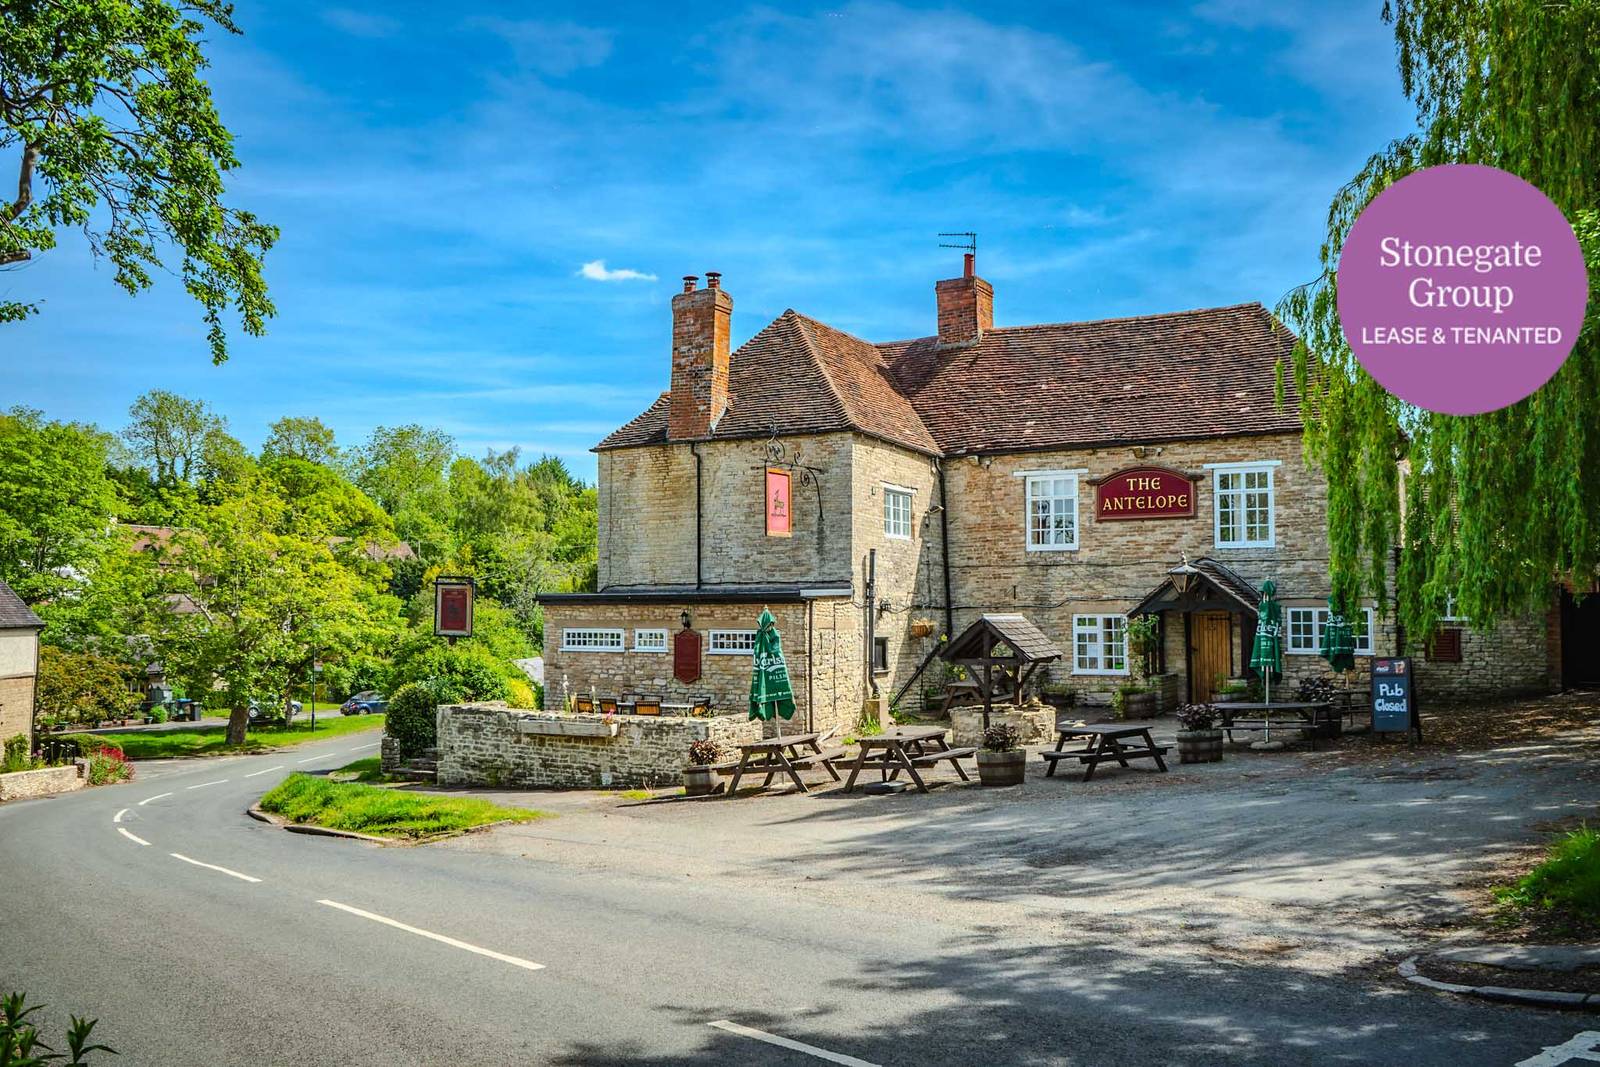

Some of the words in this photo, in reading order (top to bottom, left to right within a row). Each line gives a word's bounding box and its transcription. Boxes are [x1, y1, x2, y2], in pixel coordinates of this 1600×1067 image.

[1126, 477, 1161, 491] THE
[1102, 494, 1188, 511] ANTELOPE
[1379, 683, 1404, 697] Pub
[1374, 698, 1408, 713] Closed
